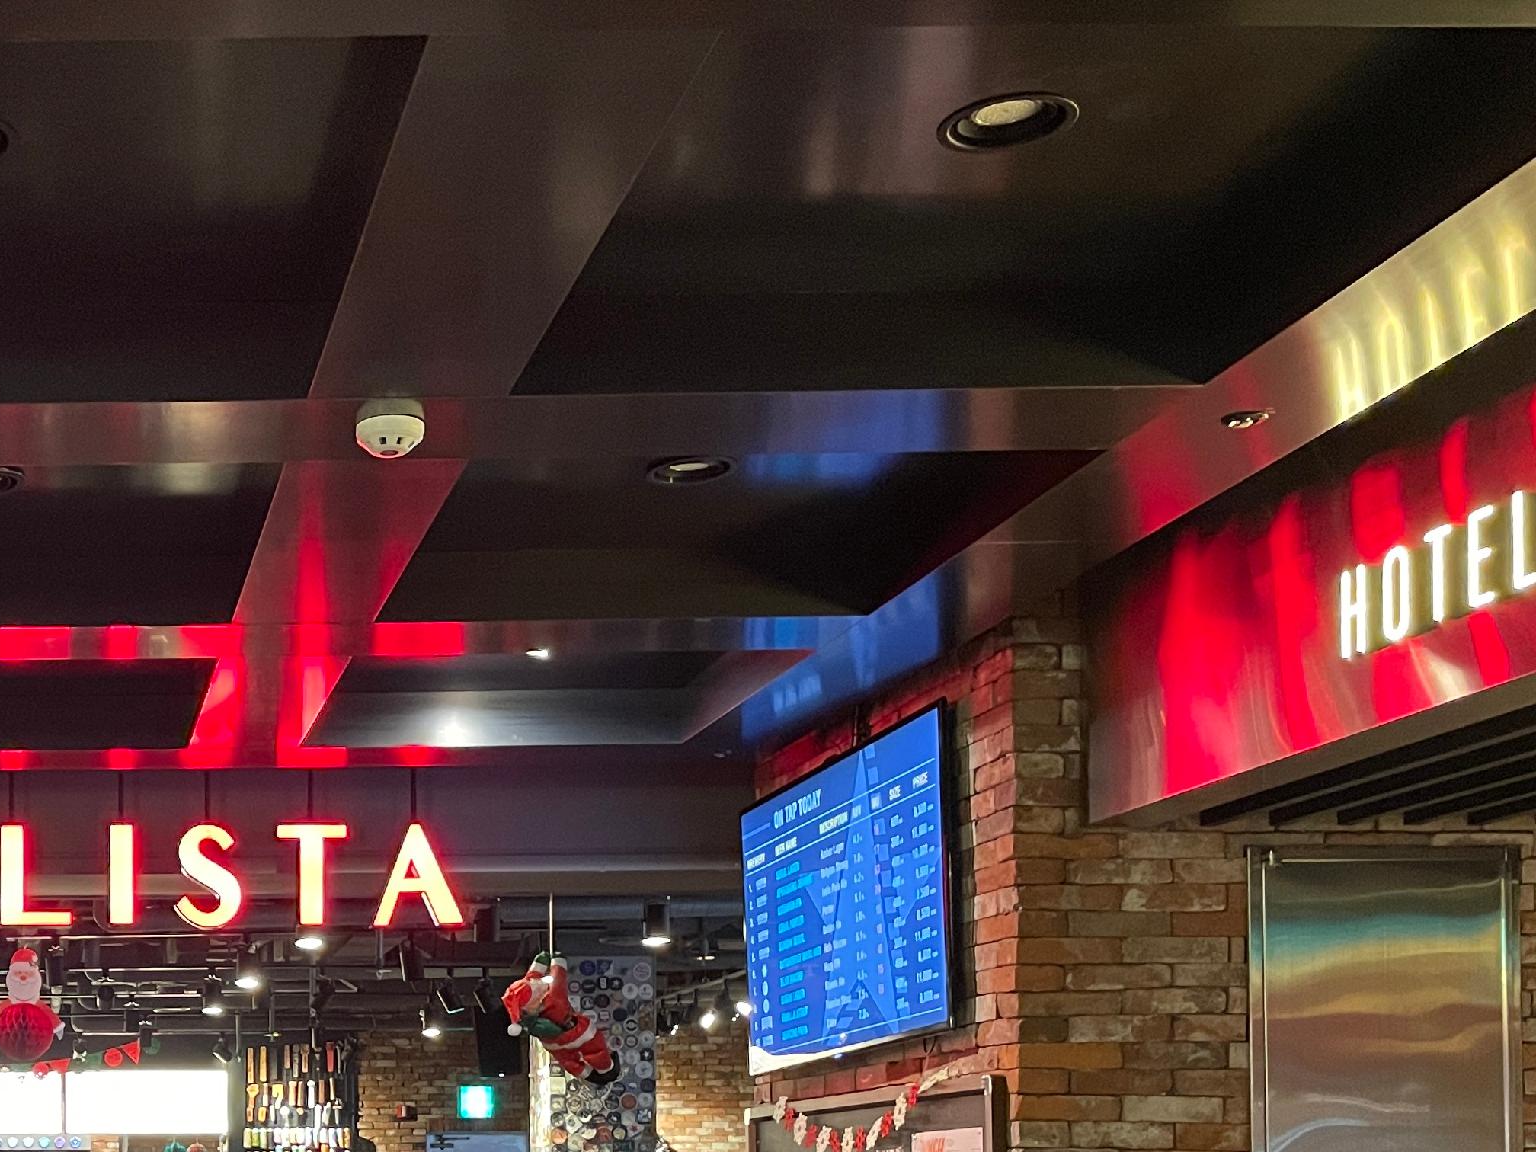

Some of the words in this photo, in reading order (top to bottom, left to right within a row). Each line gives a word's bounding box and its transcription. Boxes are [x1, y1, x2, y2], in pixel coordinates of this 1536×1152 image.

[1340, 489, 1536, 660] HOTEL
[785, 801, 798, 823] TAP
[798, 788, 822, 816] TODAY
